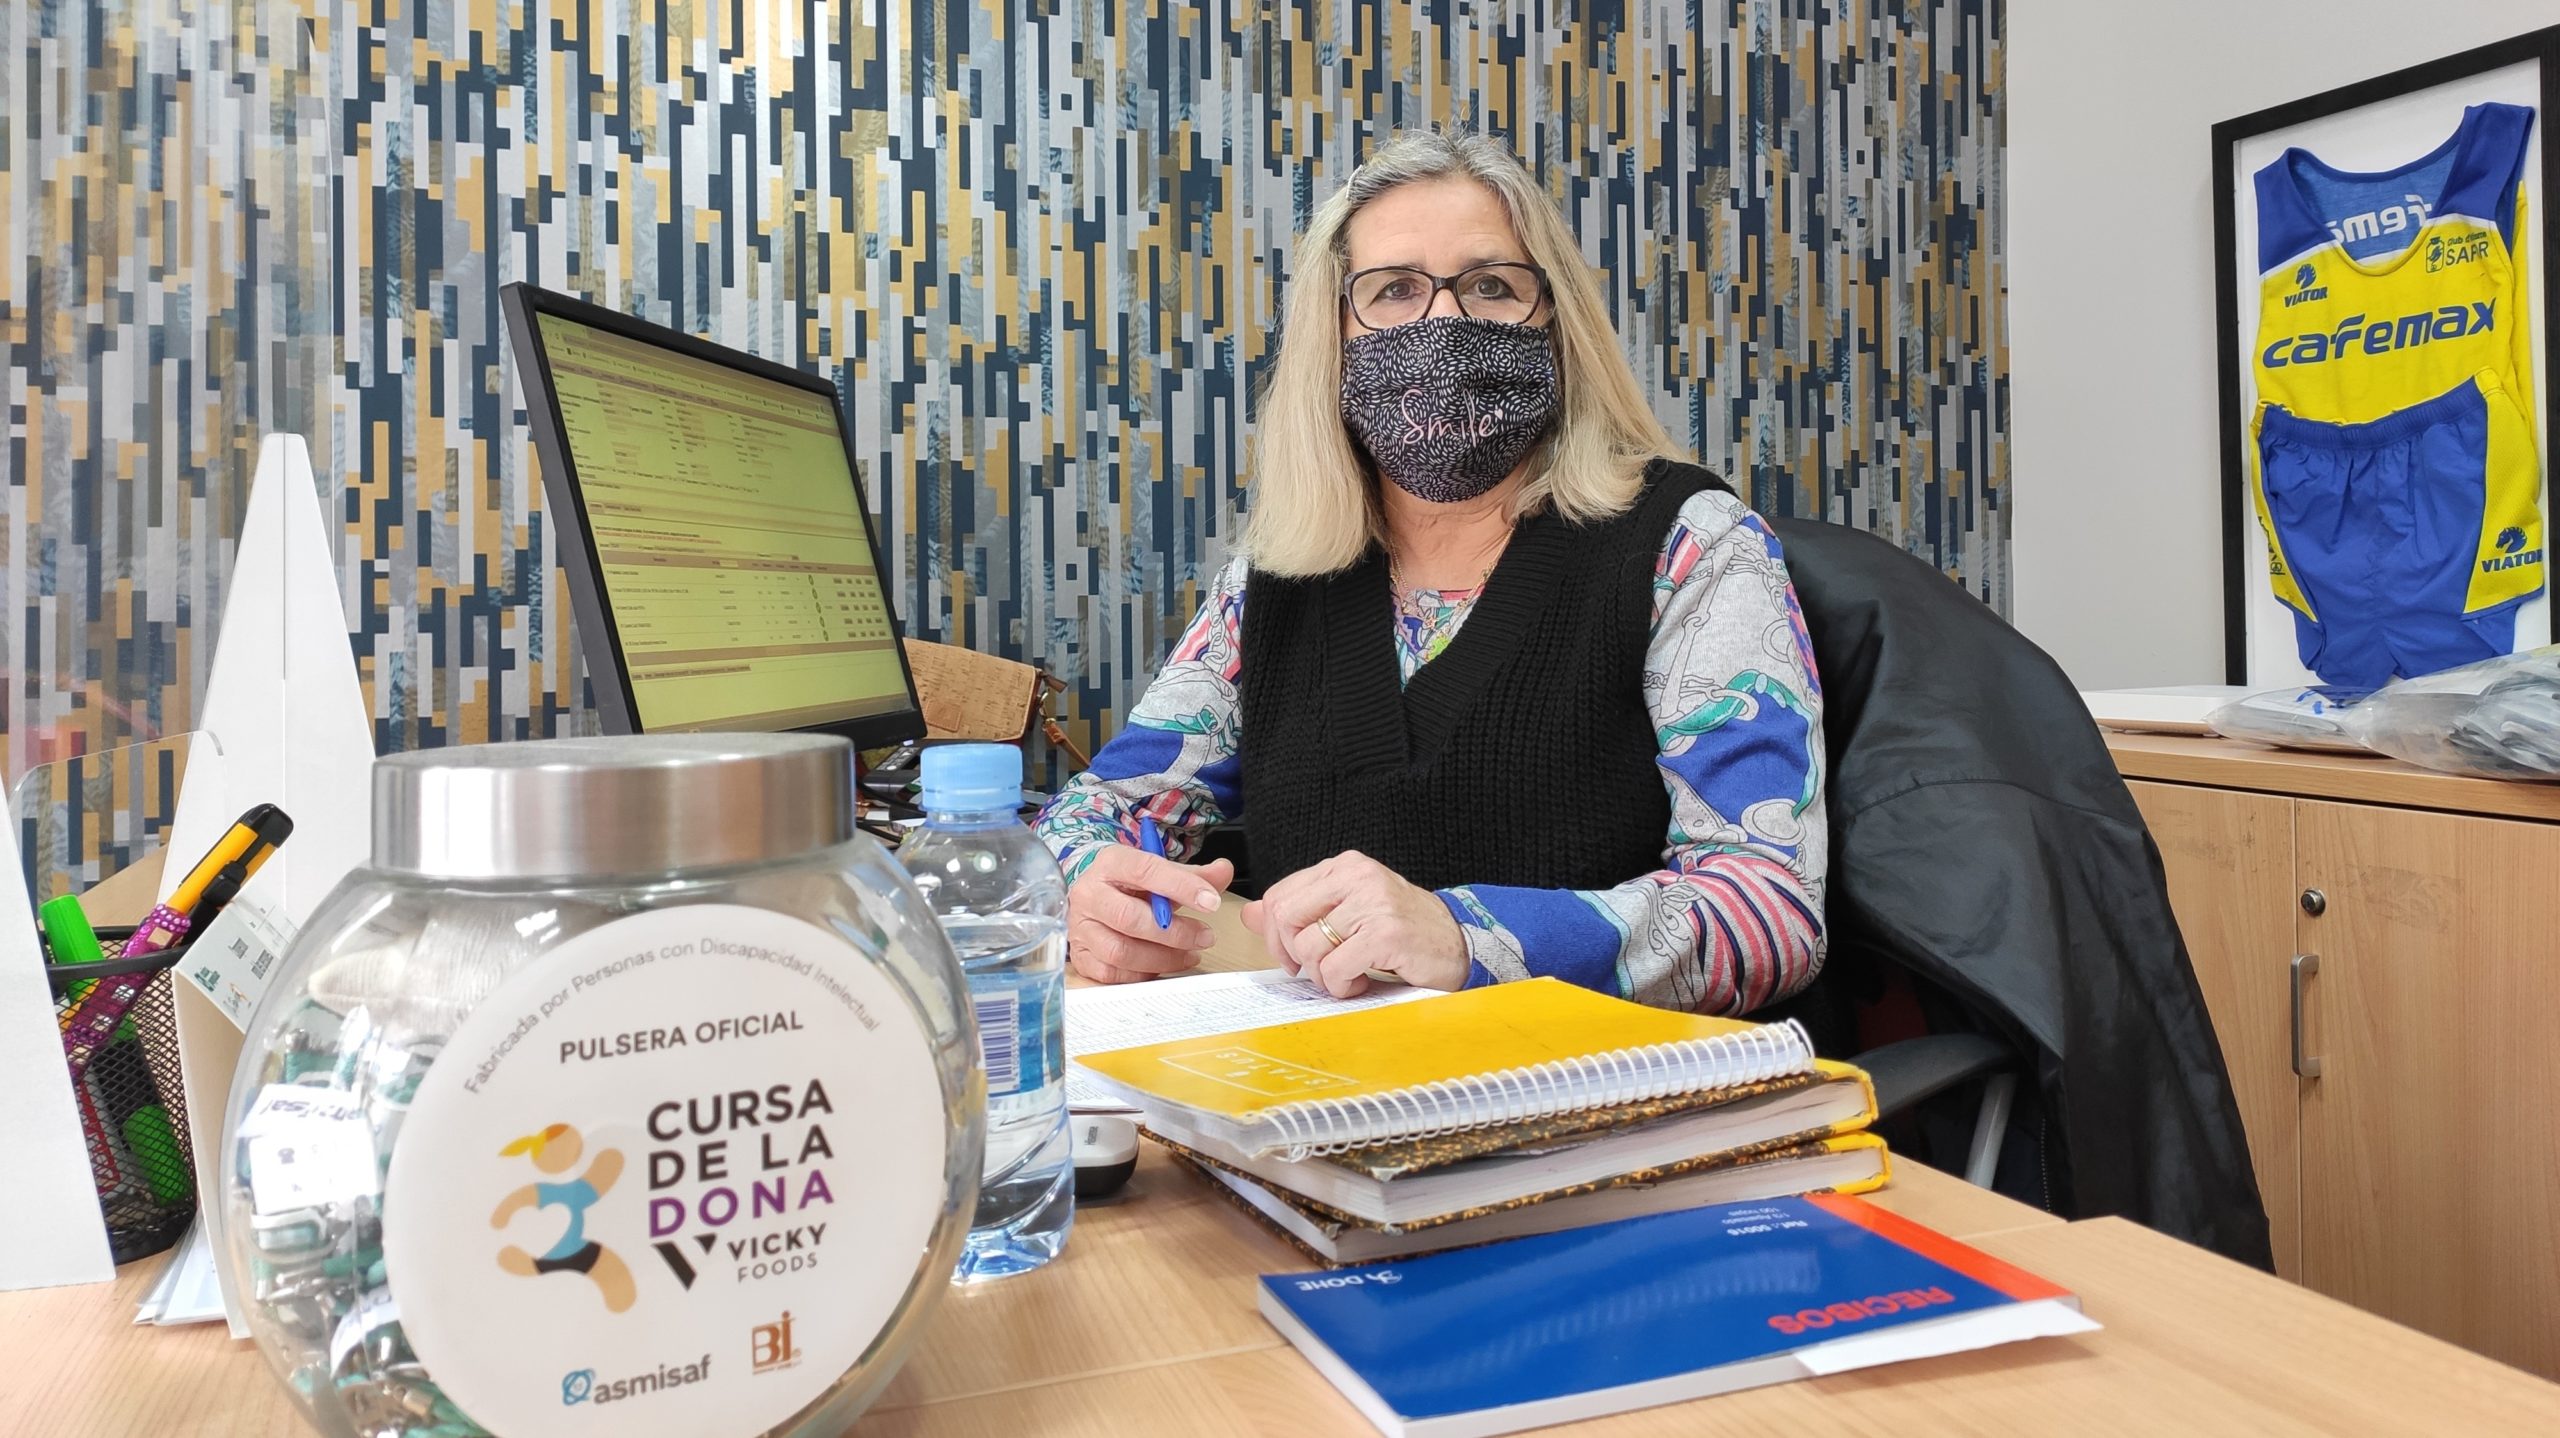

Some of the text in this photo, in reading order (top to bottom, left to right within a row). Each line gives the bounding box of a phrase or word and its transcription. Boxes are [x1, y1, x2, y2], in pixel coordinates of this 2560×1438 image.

[2284, 286, 2328, 308] VIATOR
[2262, 298, 2497, 369] cafemax
[1401, 388, 1497, 448] Smile
[463, 936, 880, 1096] Fabricada por Personas con Discapacidad Intelectual
[559, 1010, 804, 1064] PULSERA OFICIAL
[646, 1078, 833, 1142] CURSA
[648, 1124, 834, 1191] DE LA
[648, 1169, 835, 1239] DONA
[727, 1222, 828, 1262] VICKY
[737, 1253, 819, 1284] FOODS
[1295, 1275, 1364, 1291] DOHE
[1767, 1286, 1955, 1335] RECIBOS
[593, 1353, 712, 1405] asmisaf
